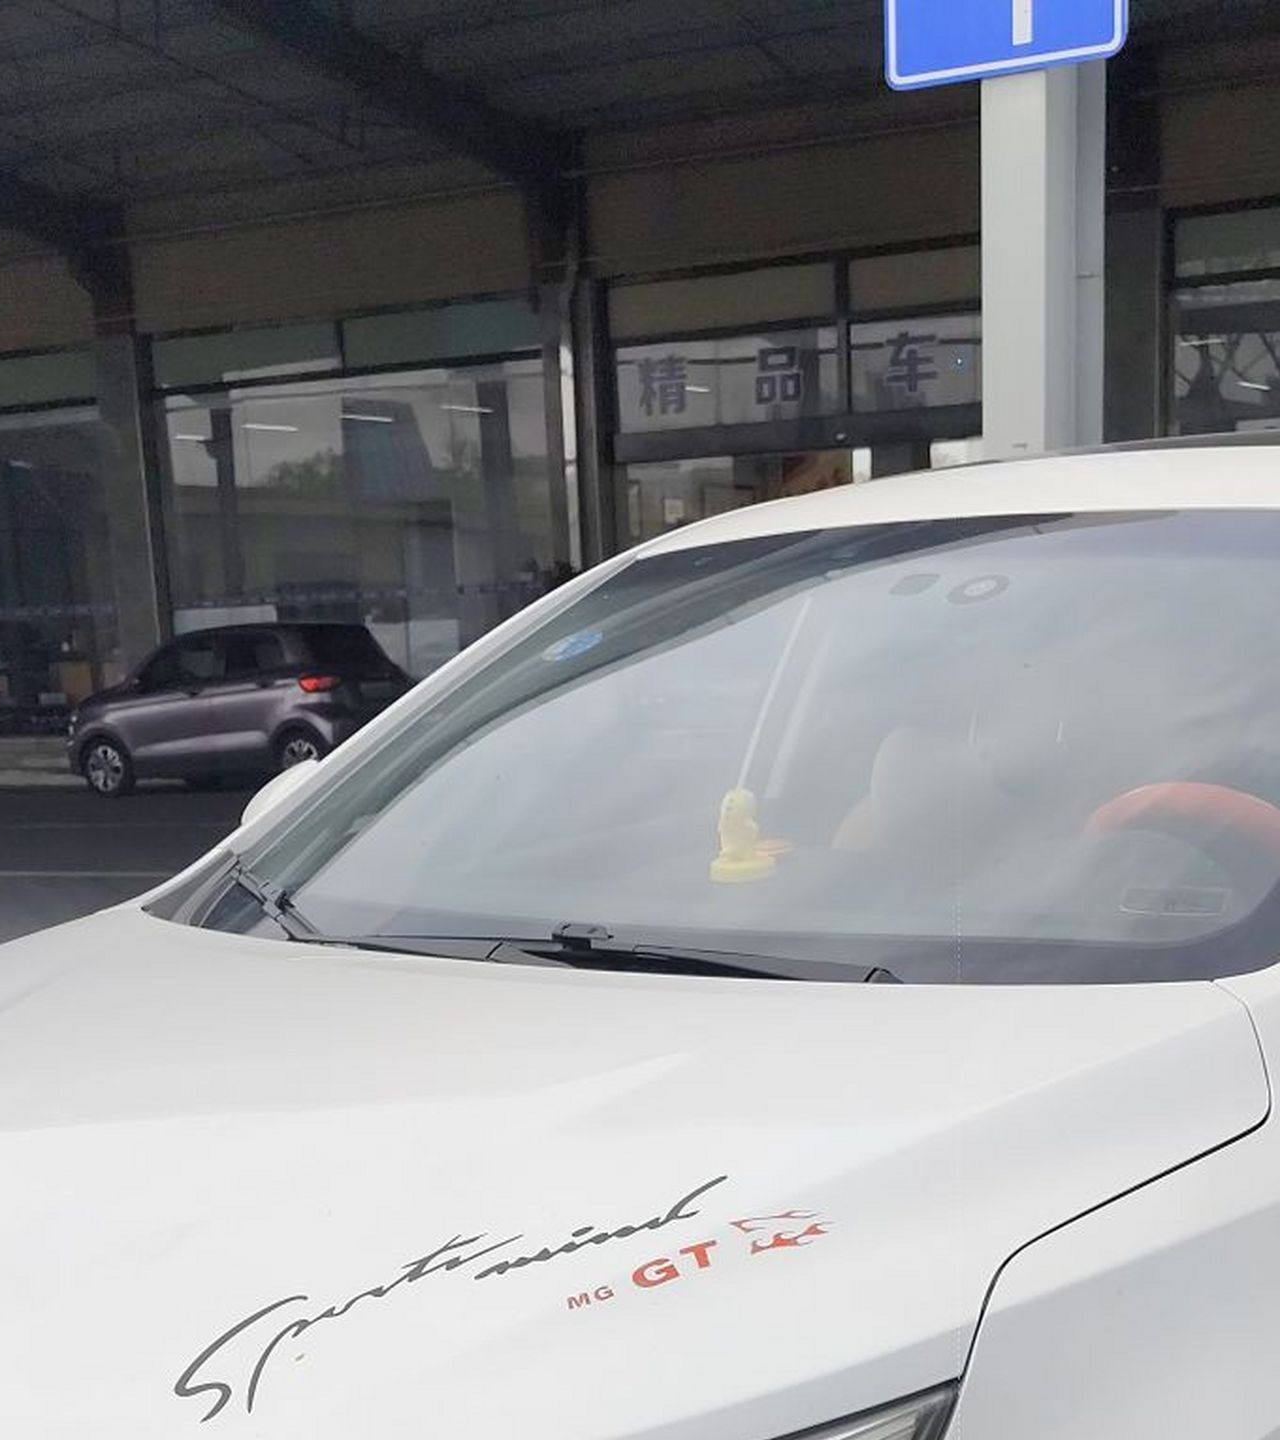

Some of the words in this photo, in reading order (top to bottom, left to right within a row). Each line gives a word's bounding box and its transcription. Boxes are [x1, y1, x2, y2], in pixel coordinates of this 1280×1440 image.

[637, 331, 940, 417] 精品车
[566, 1285, 616, 1311] MG
[631, 1239, 719, 1290] GT
